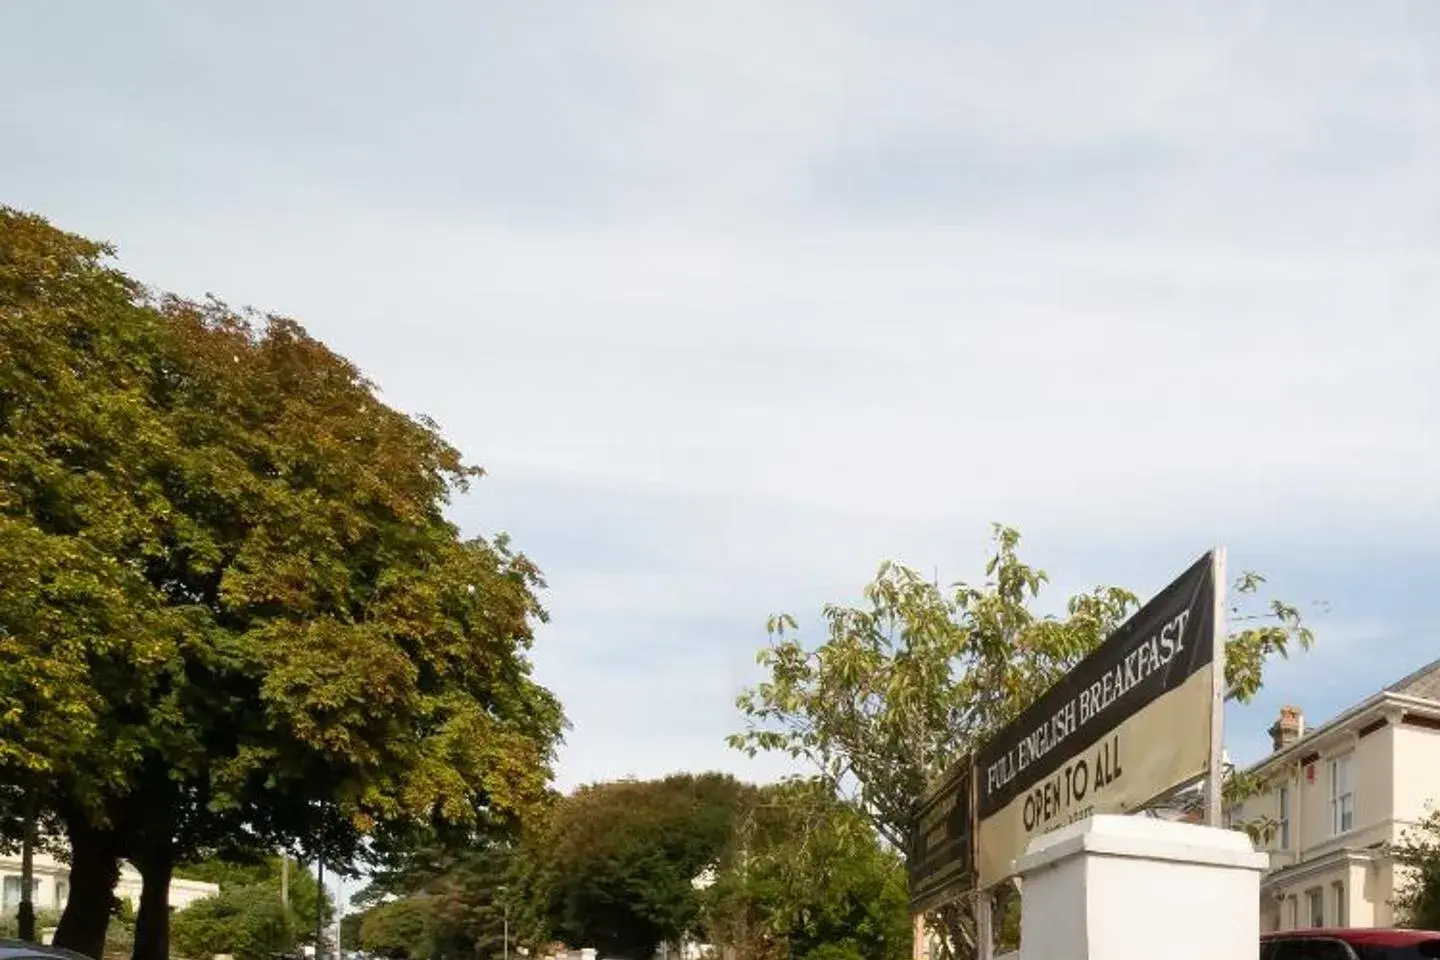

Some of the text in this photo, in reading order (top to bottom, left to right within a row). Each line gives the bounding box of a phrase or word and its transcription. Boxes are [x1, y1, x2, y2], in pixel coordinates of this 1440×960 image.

[988, 609, 1190, 795] FULL ENGLISH BREAKFAST
[1023, 775, 1061, 832] OPEN
[1065, 760, 1088, 807] TO
[1094, 734, 1122, 792] ALL
